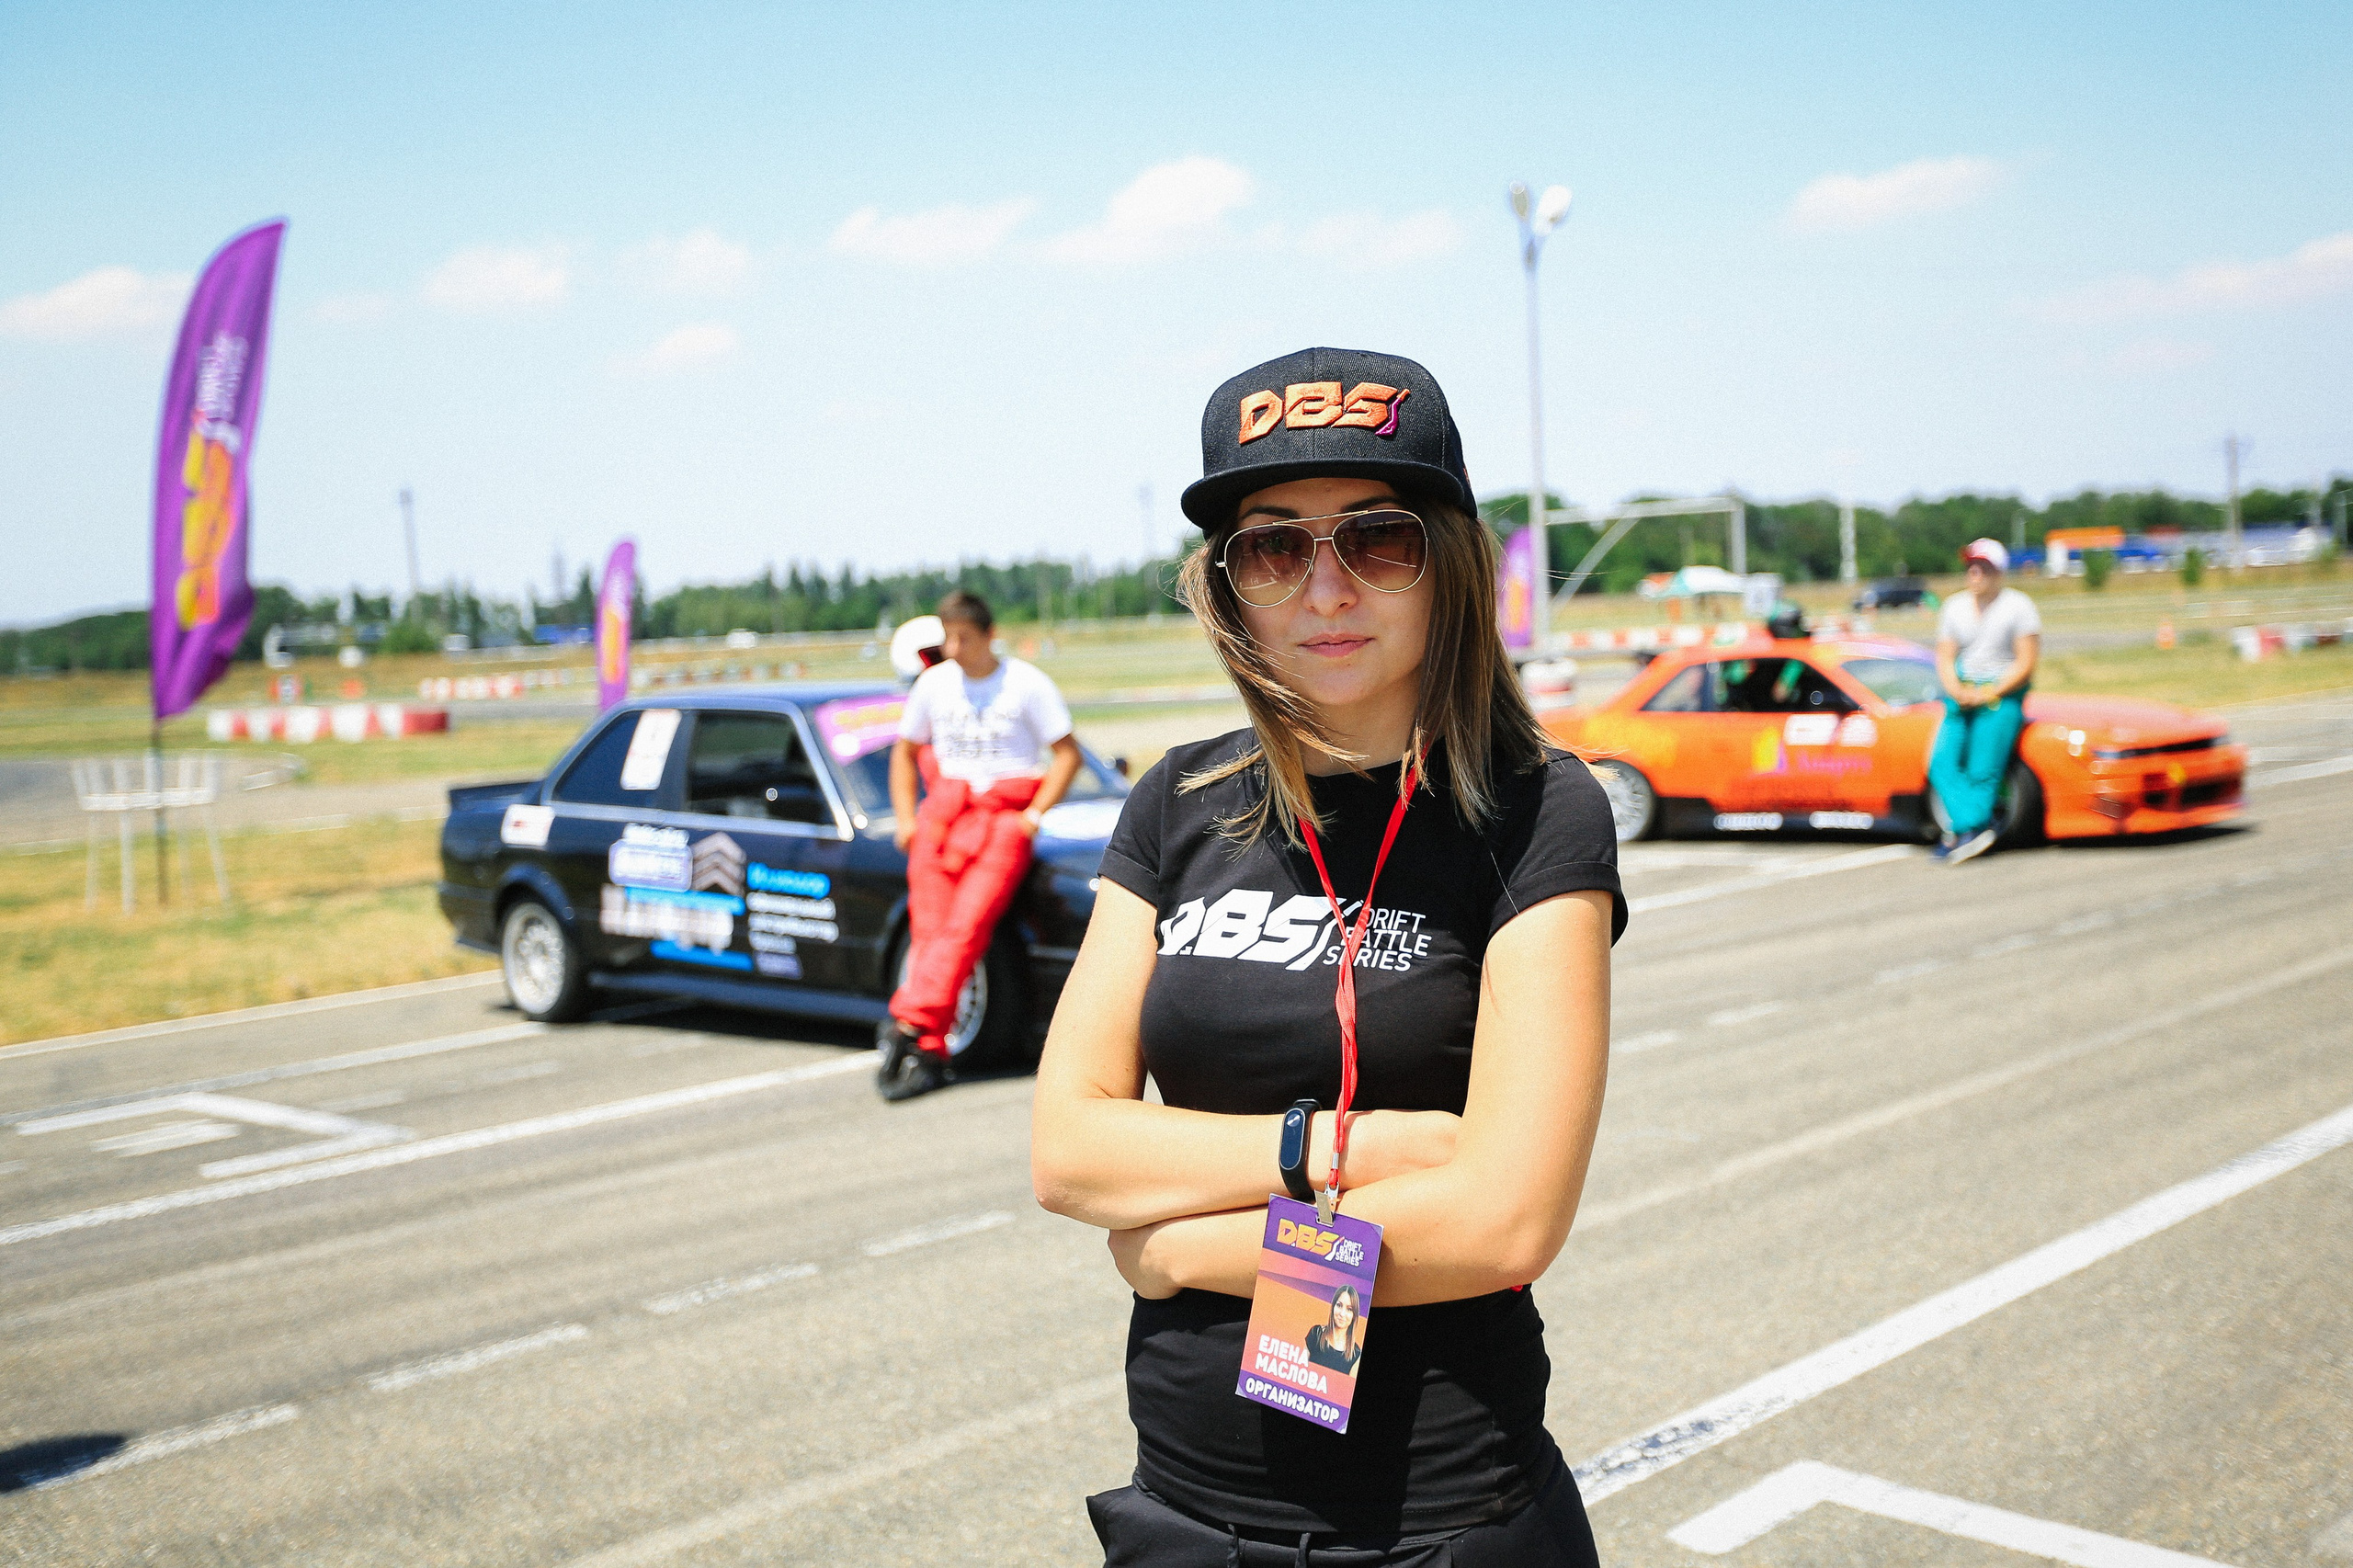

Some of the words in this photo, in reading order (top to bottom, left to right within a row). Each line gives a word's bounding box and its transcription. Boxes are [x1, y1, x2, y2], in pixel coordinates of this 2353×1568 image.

[1238, 381, 1398, 445] DBS
[1276, 1218, 1340, 1256] DBS
[1338, 1244, 1365, 1261] BATTLE
[1343, 1238, 1363, 1253] DRIFT
[1335, 1251, 1360, 1267] SERIES
[1258, 1334, 1310, 1368] ЕЛЕНА
[1255, 1352, 1328, 1394] МАСЛОВА
[1245, 1377, 1340, 1425] ОРГАНИЗАТОР
